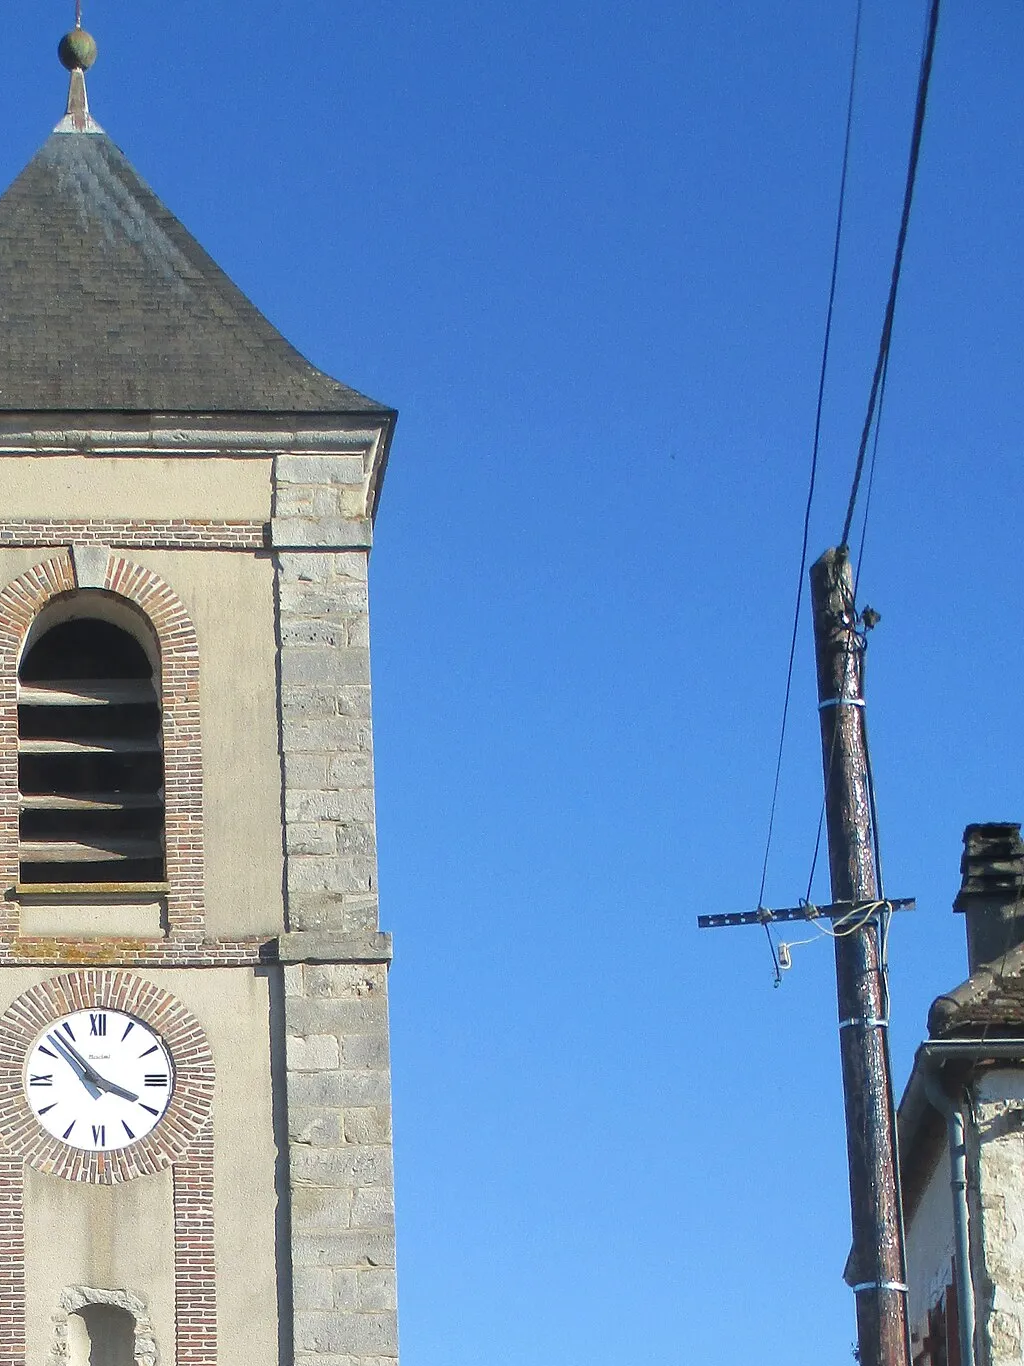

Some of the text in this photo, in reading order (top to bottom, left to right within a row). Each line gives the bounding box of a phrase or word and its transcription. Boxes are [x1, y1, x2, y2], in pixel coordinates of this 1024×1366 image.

[89, 1014, 107, 1036] XII
[29, 1074, 53, 1086] IX
[144, 1074, 167, 1087] III
[92, 1125, 105, 1147] VI
